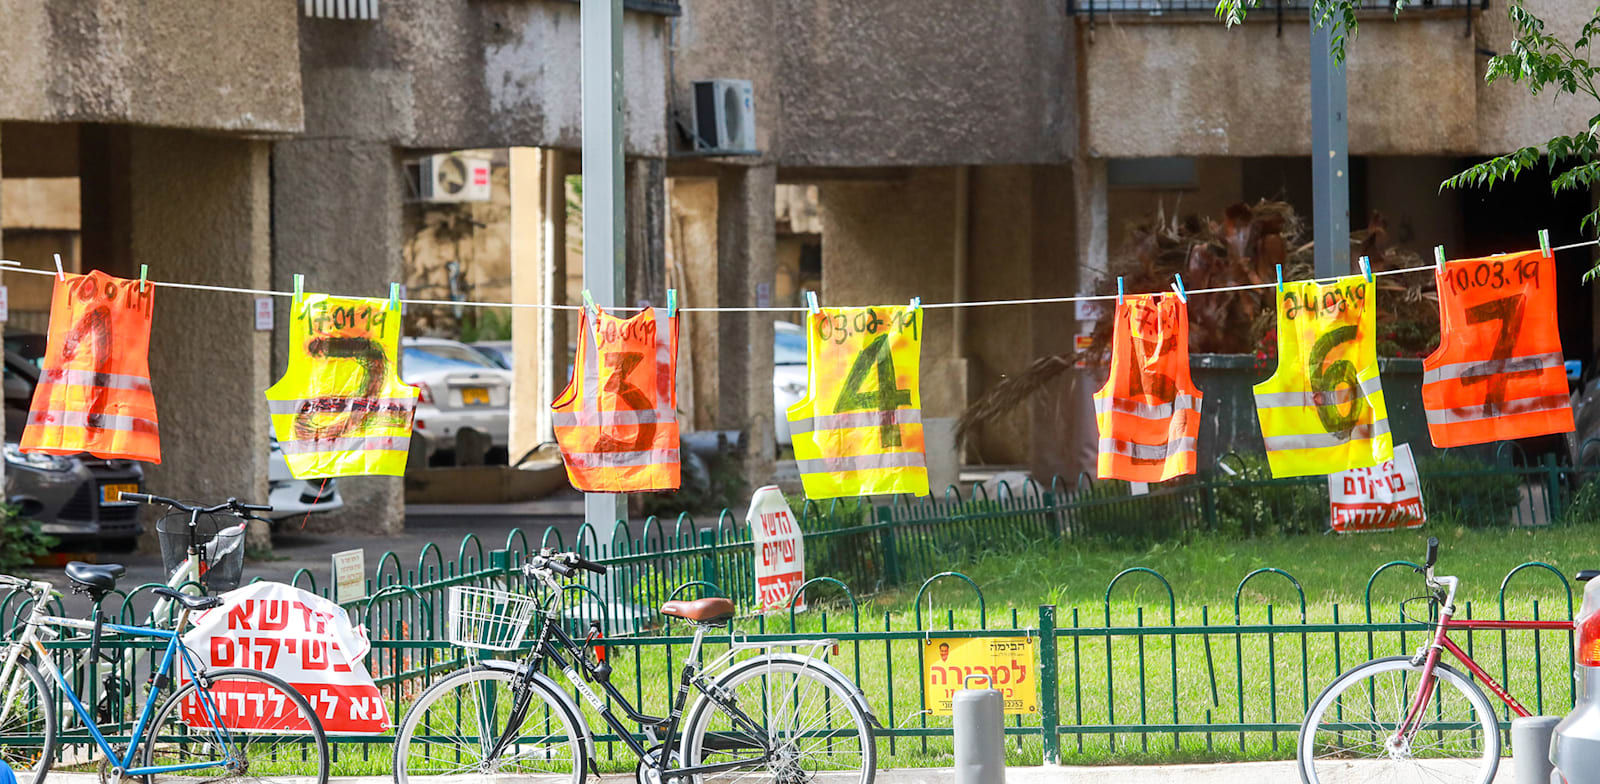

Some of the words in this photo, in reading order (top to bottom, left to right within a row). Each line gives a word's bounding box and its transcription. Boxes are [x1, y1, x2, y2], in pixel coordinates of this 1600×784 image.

[1445, 260, 1540, 296] 10.03.19
[62, 304, 113, 434] 1
[294, 336, 408, 441] 2
[593, 351, 658, 464] 3
[833, 333, 912, 448] 4
[1309, 325, 1364, 440] 6
[1460, 293, 1544, 418] 7
[931, 659, 1027, 685] למכירה
[990, 643, 1025, 651] הבימה
[349, 696, 384, 721] נא
